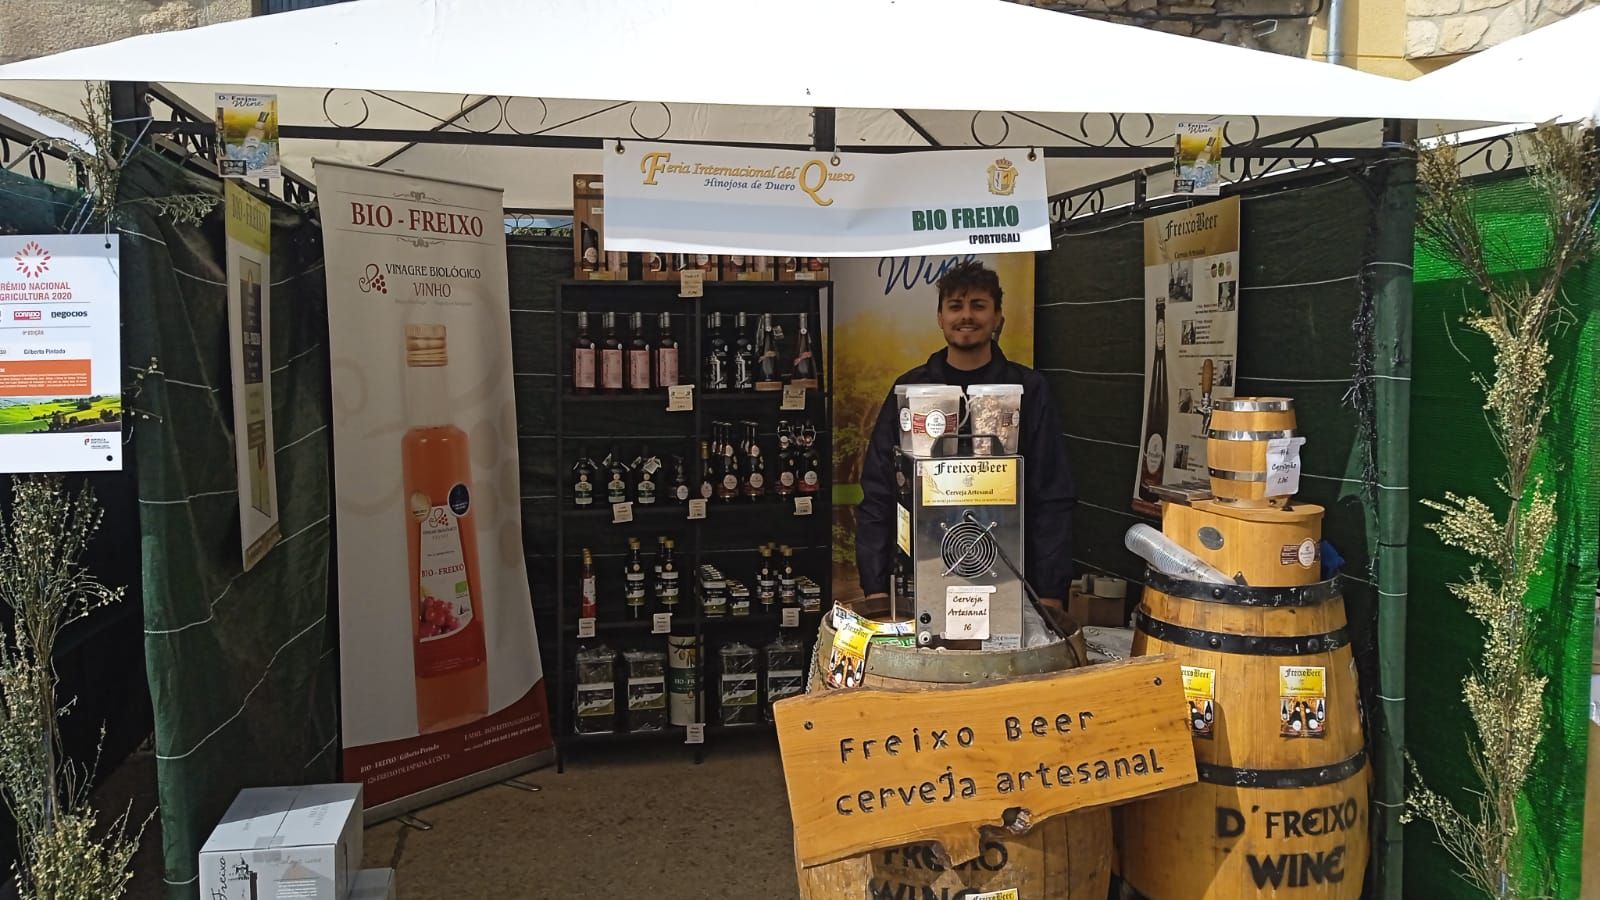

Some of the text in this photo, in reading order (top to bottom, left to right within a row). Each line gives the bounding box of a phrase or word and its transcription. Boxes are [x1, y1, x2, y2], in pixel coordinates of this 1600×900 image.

[639, 151, 856, 206] Feria Internacional del Queso
[704, 178, 796, 191] Hinojosa de Duero
[350, 202, 393, 228] BIO
[408, 209, 483, 238] FREIXO
[912, 205, 1020, 231] BIO FREIXO
[969, 232, 1021, 245] (PORTUGAL)
[385, 264, 481, 279] VINAGRE BIOLÓGICO
[0, 282, 26, 290] RÉMIO
[413, 282, 451, 298] VINHO
[0, 293, 50, 301] GRICULTURA
[934, 460, 1008, 476] FreixoBeer
[948, 608, 987, 616] Artesanal
[840, 710, 1094, 764] Freixo Beer
[836, 766, 977, 816] cerveja
[1246, 845, 1346, 890] WINE
